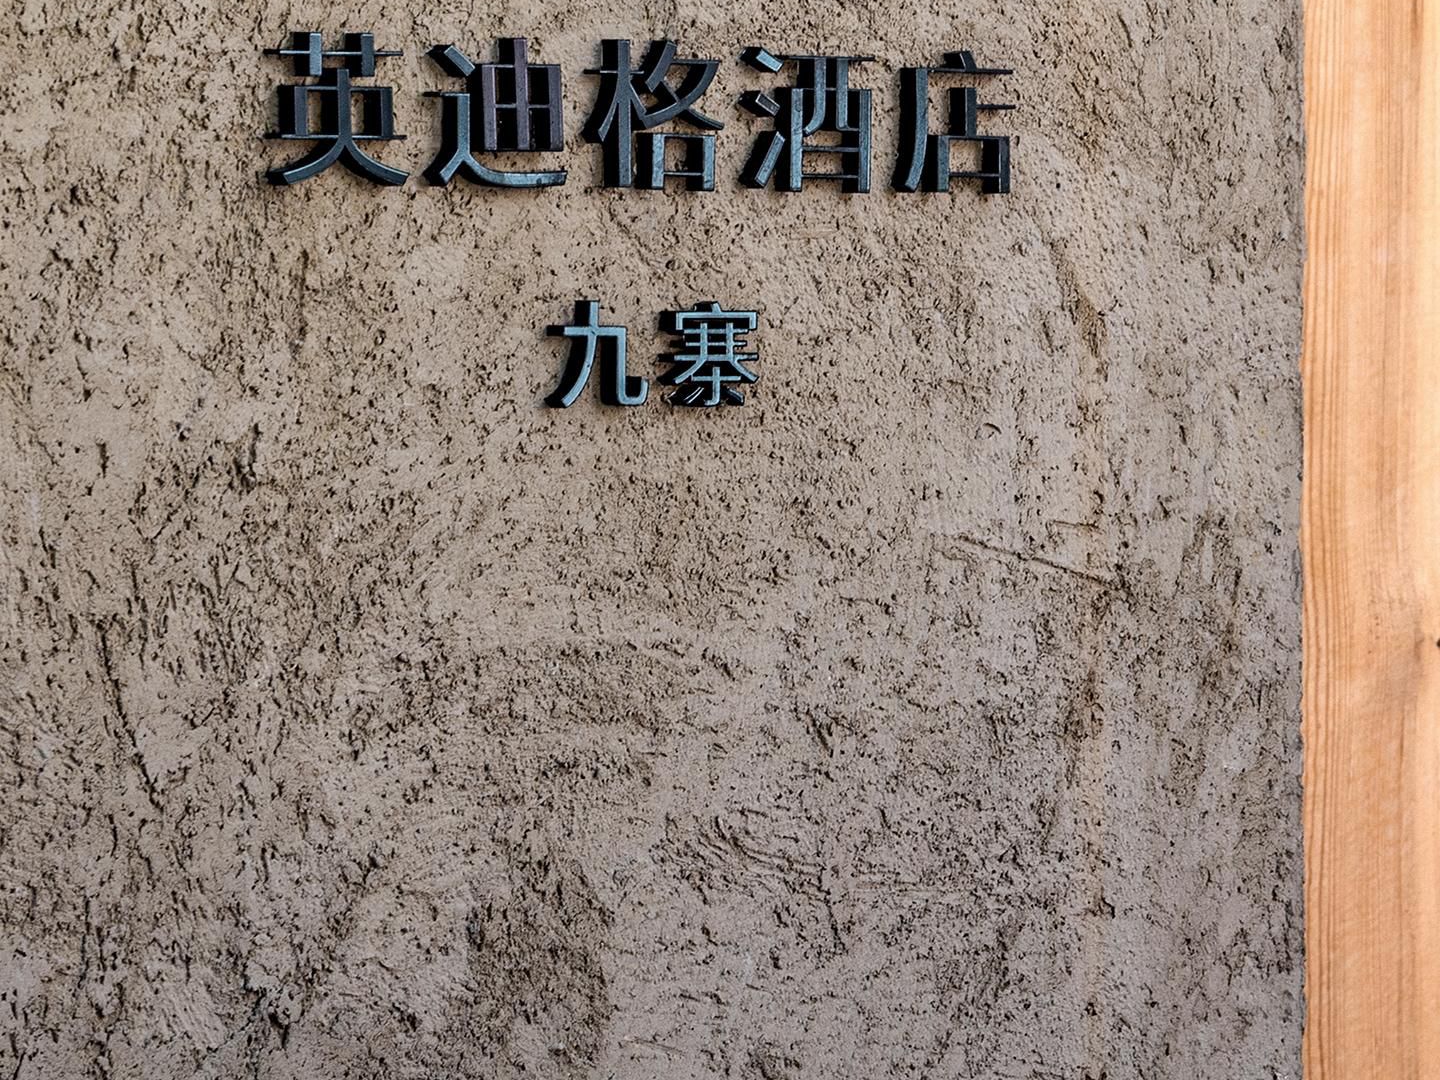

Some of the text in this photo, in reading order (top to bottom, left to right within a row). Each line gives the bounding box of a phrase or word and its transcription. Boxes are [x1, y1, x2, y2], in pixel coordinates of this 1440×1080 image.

[263, 31, 1017, 195] 英迪格酒店
[546, 300, 760, 408] 九寨
